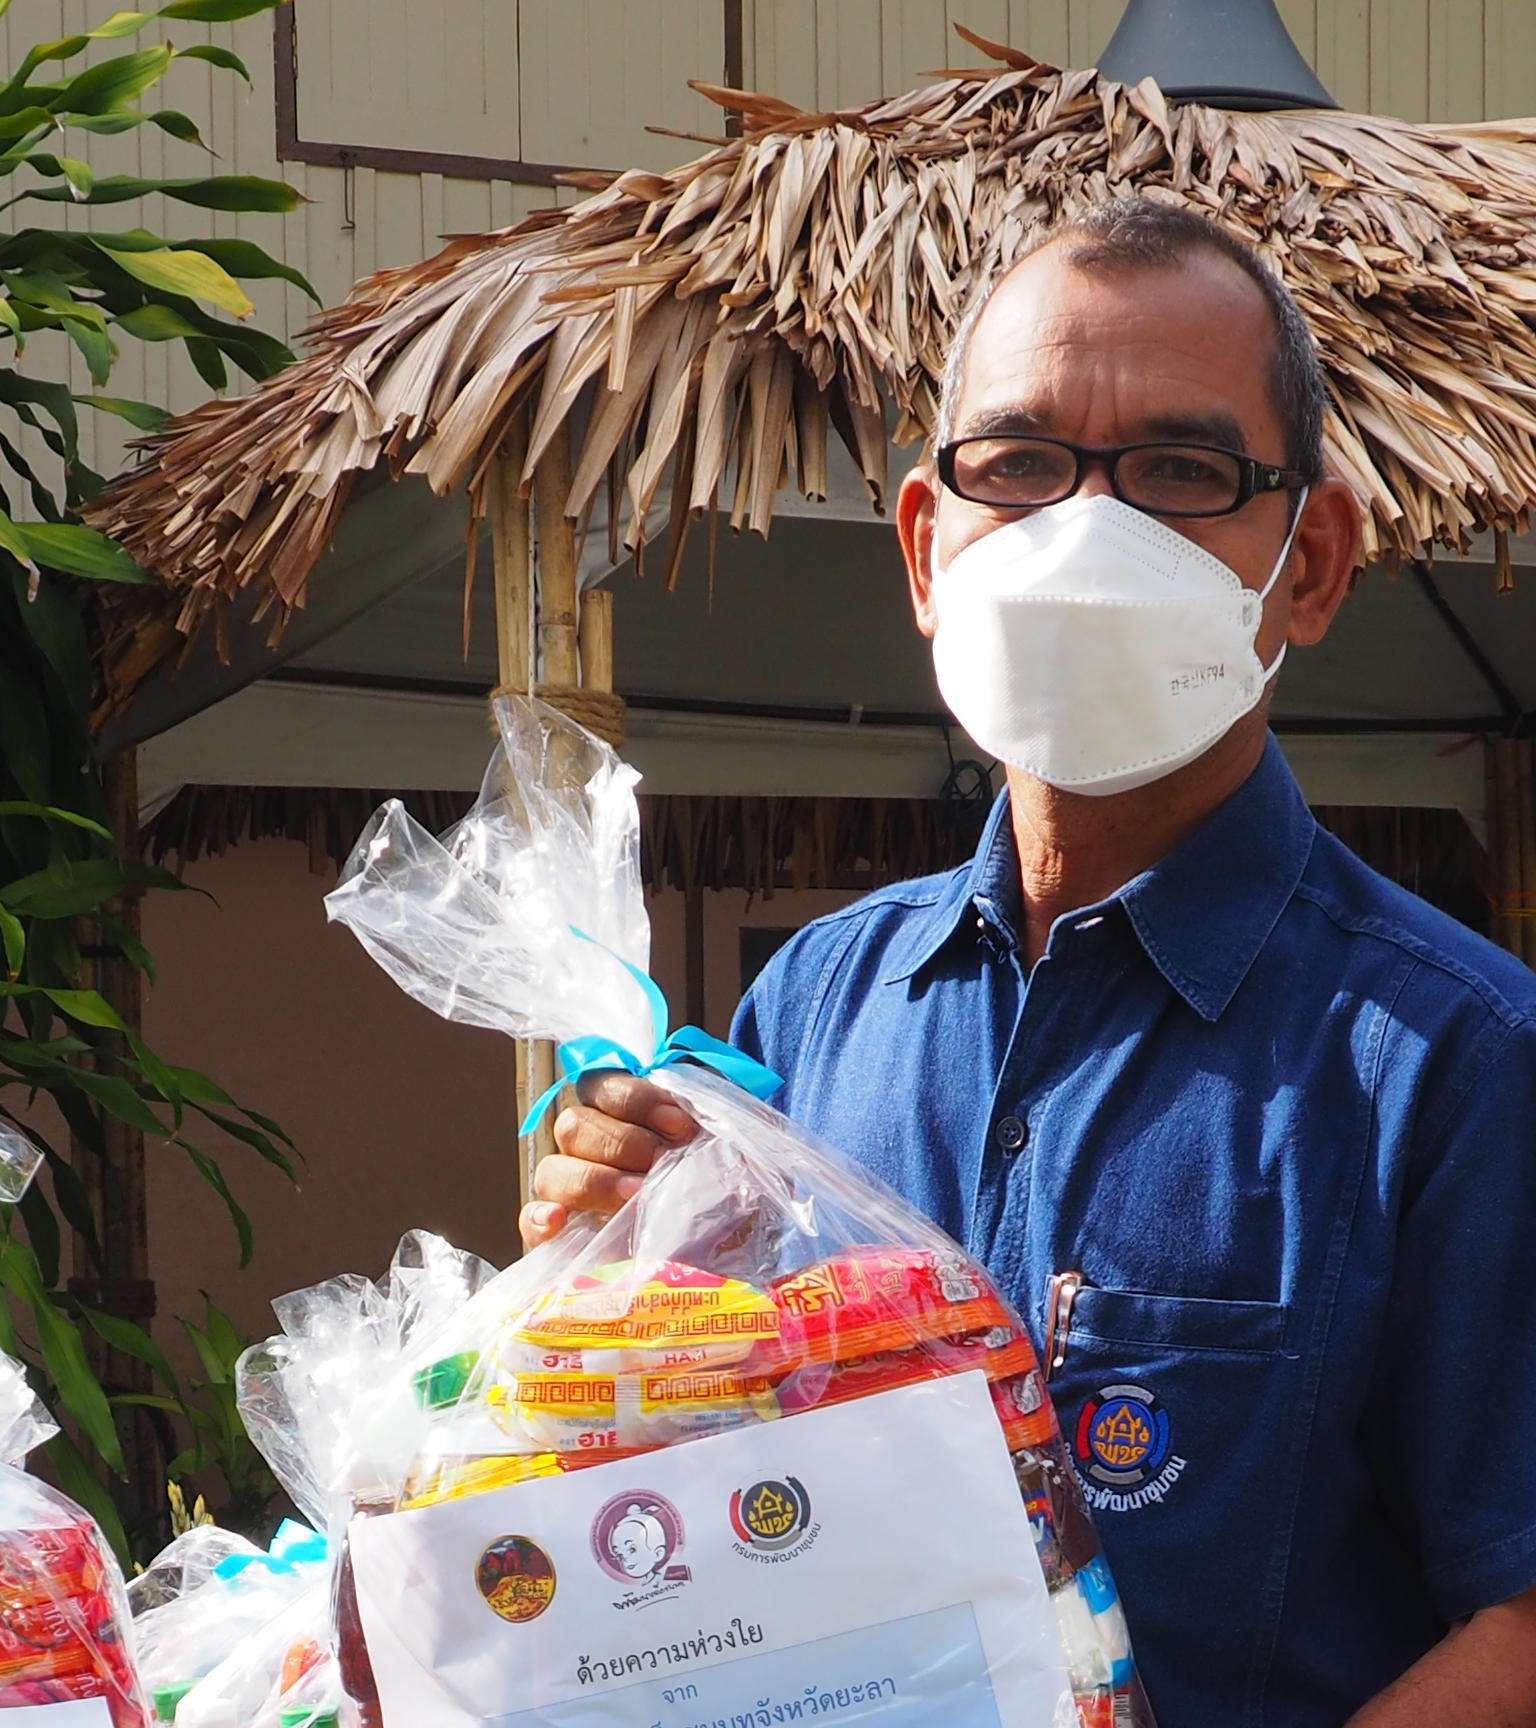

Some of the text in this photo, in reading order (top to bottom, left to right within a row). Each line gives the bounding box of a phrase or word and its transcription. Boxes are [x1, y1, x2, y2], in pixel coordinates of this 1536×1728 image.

[731, 1521, 822, 1566] กรมการพัฒนาชุมชน
[577, 1619, 765, 1687] ด้วยความห่วงใย
[662, 1681, 699, 1706] จาก
